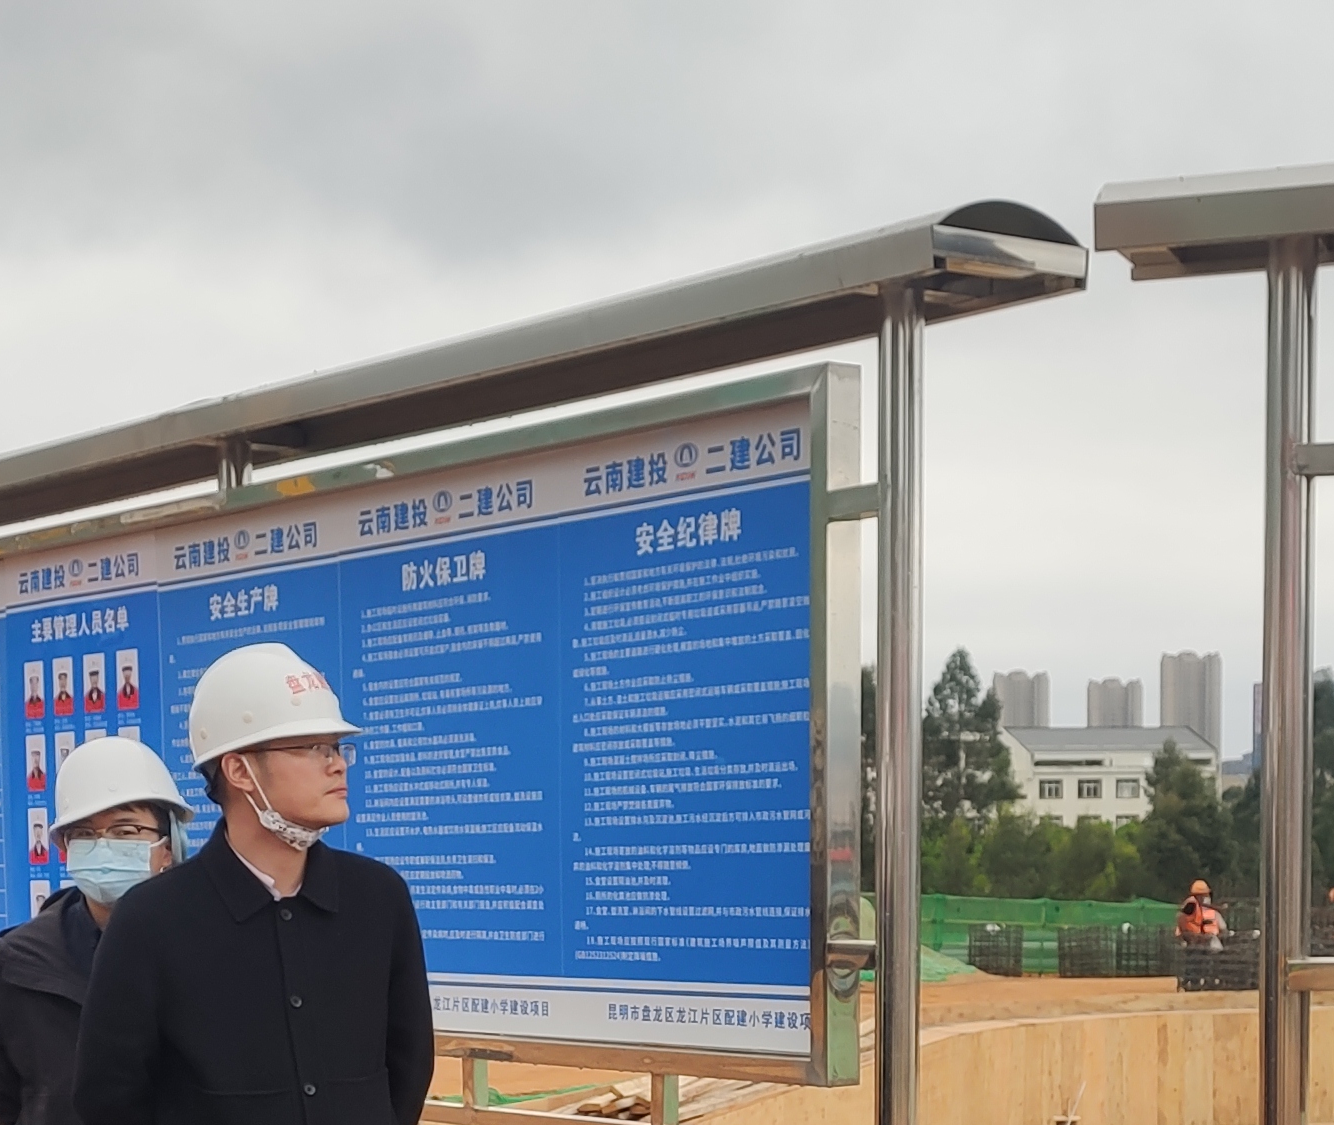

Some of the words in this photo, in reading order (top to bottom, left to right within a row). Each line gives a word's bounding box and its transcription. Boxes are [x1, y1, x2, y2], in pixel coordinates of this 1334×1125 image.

[583, 452, 668, 498] 云南建投
[706, 427, 802, 475] 二建公司
[357, 498, 429, 538] 云南建投
[458, 480, 534, 519] 二建公司
[635, 508, 742, 556] 安全纪律牌
[173, 539, 231, 572] 云南建投
[254, 521, 318, 556] 二建公司
[17, 563, 65, 596] 云南建投
[87, 552, 140, 584] 二建公司
[400, 551, 487, 592] 防火保卫牌
[208, 584, 279, 622] 安全生产牌
[30, 611, 129, 644] 主要管理人员名单
